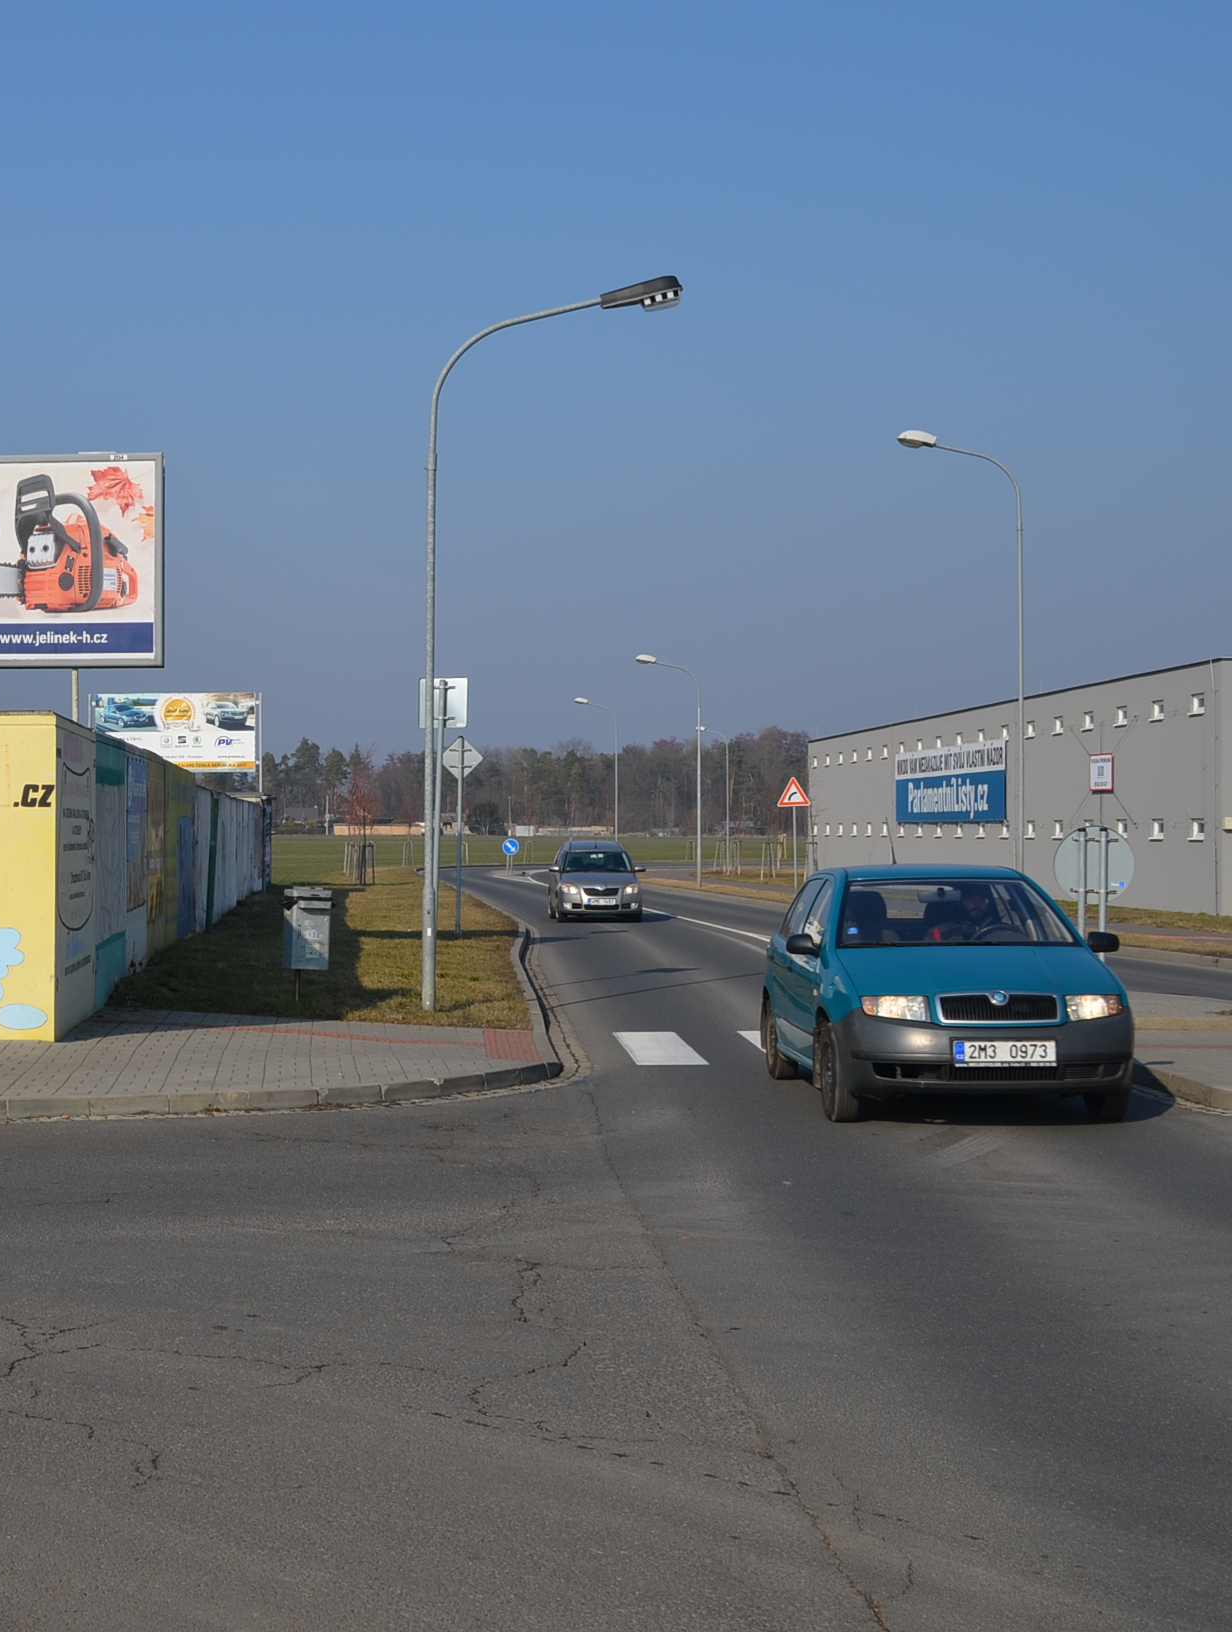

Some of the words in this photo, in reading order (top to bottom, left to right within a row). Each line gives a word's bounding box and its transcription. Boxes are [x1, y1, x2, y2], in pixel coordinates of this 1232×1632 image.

[0, 631, 108, 646] www.jelinek-h.cz
[986, 742, 1004, 766] NÁZOR
[908, 777, 988, 820] ParlamentníListy.cz
[968, 1044, 996, 1059] 2M3
[1010, 1044, 1048, 1059] 0973
